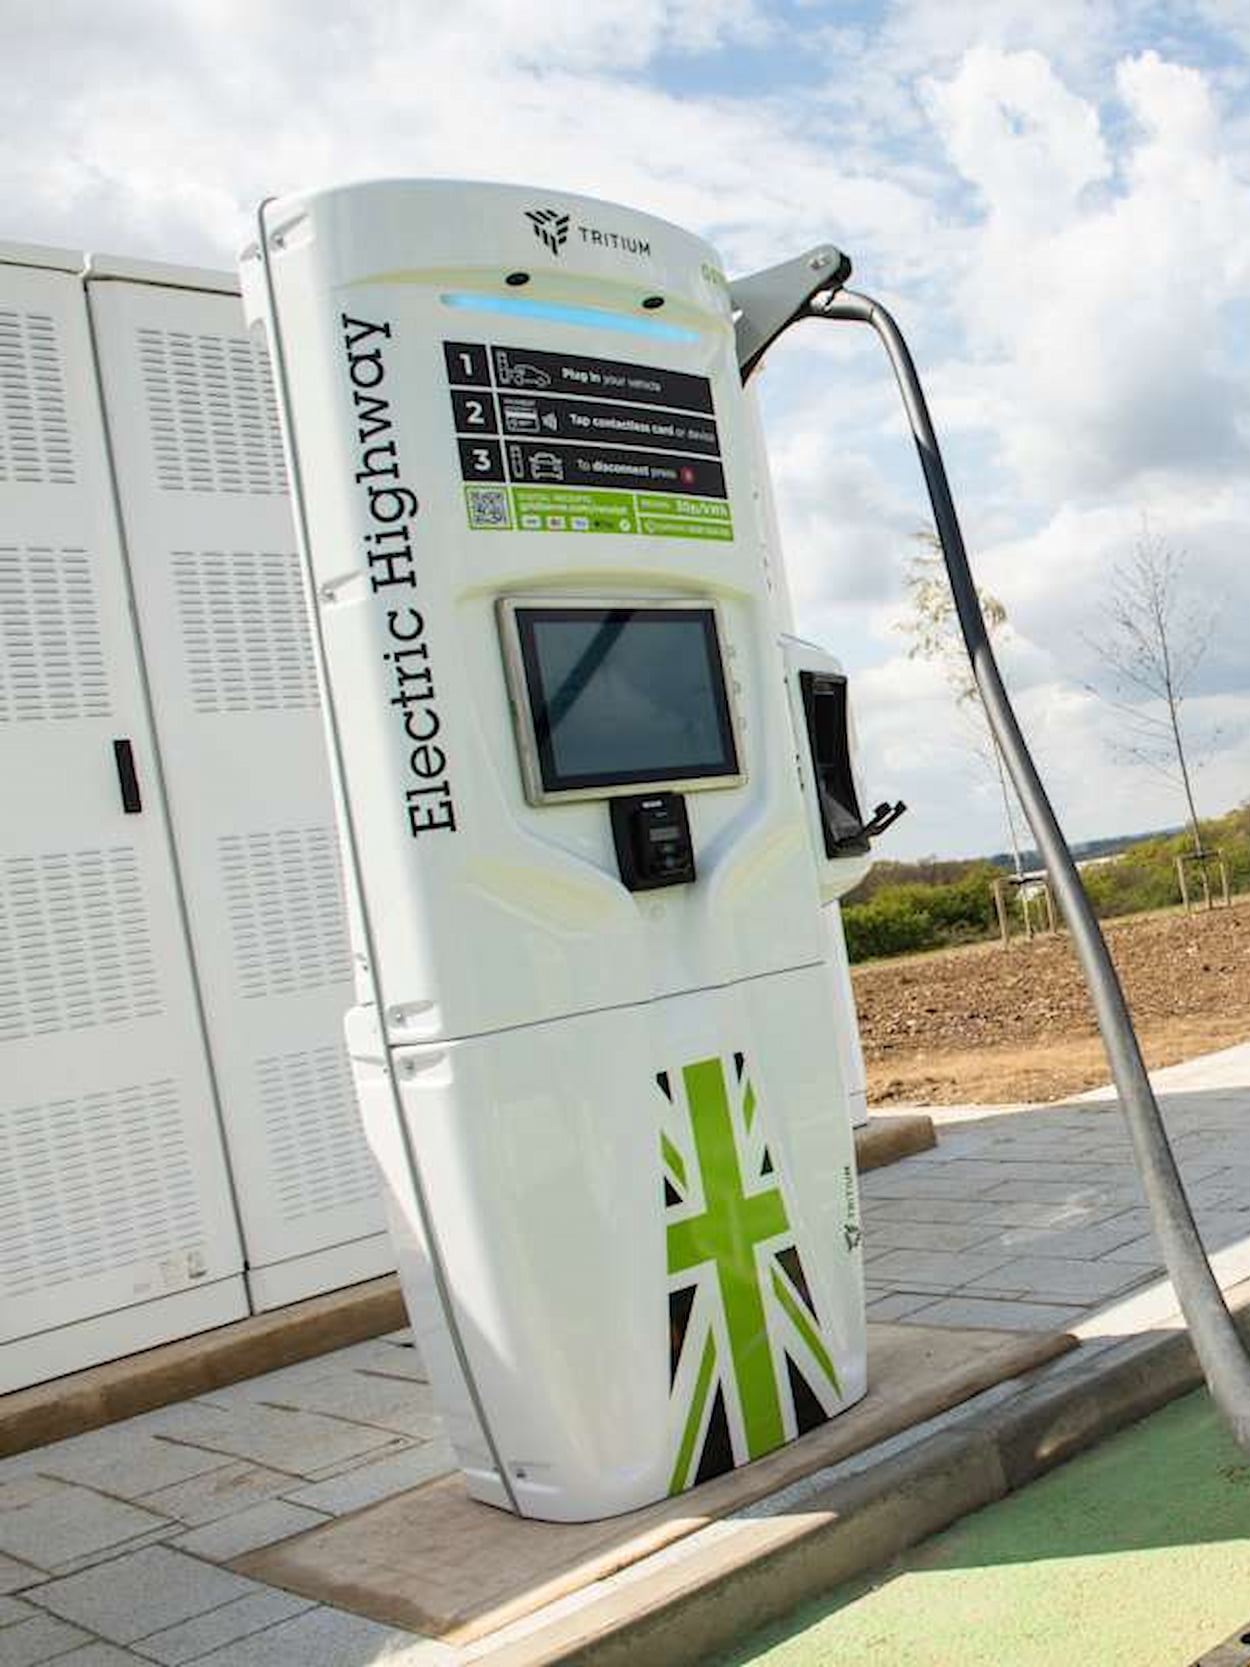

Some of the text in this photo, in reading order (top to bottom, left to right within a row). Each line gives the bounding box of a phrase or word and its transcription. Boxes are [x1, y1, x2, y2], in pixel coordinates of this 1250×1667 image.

[578, 227, 651, 257] TRITIUM
[459, 352, 473, 376] 1
[561, 367, 588, 384] Plug
[590, 370, 601, 383] in
[465, 400, 486, 425] 2
[569, 413, 591, 428] Tap
[592, 416, 651, 433] contactless
[651, 423, 676, 437] card
[472, 448, 492, 472] 3
[577, 459, 592, 473] To
[592, 461, 650, 478] disconnect
[342, 313, 457, 838] Electric Highway
